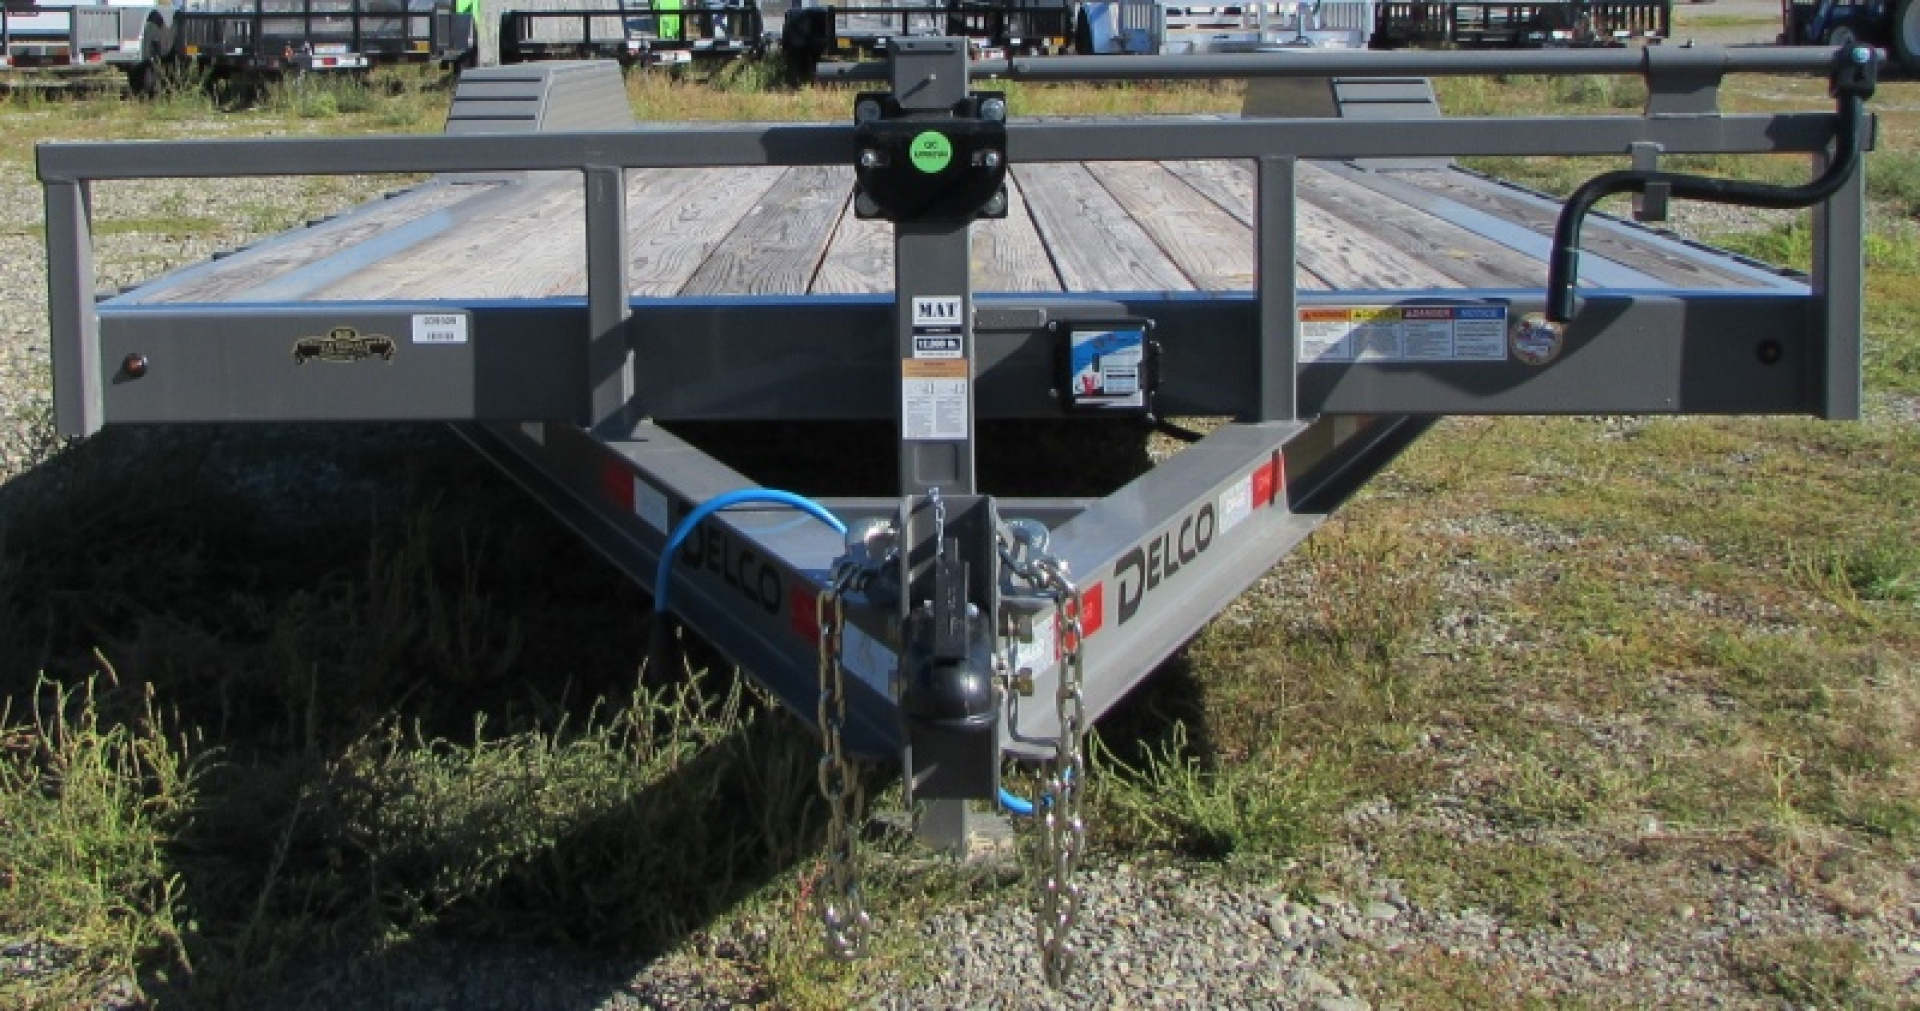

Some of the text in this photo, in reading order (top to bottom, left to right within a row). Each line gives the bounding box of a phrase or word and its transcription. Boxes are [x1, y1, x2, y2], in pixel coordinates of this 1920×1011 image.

[918, 302, 959, 318] MAT
[1412, 309, 1451, 318] DANGER
[1460, 309, 1497, 318] NOTICE
[1113, 502, 1216, 626] DELCO
